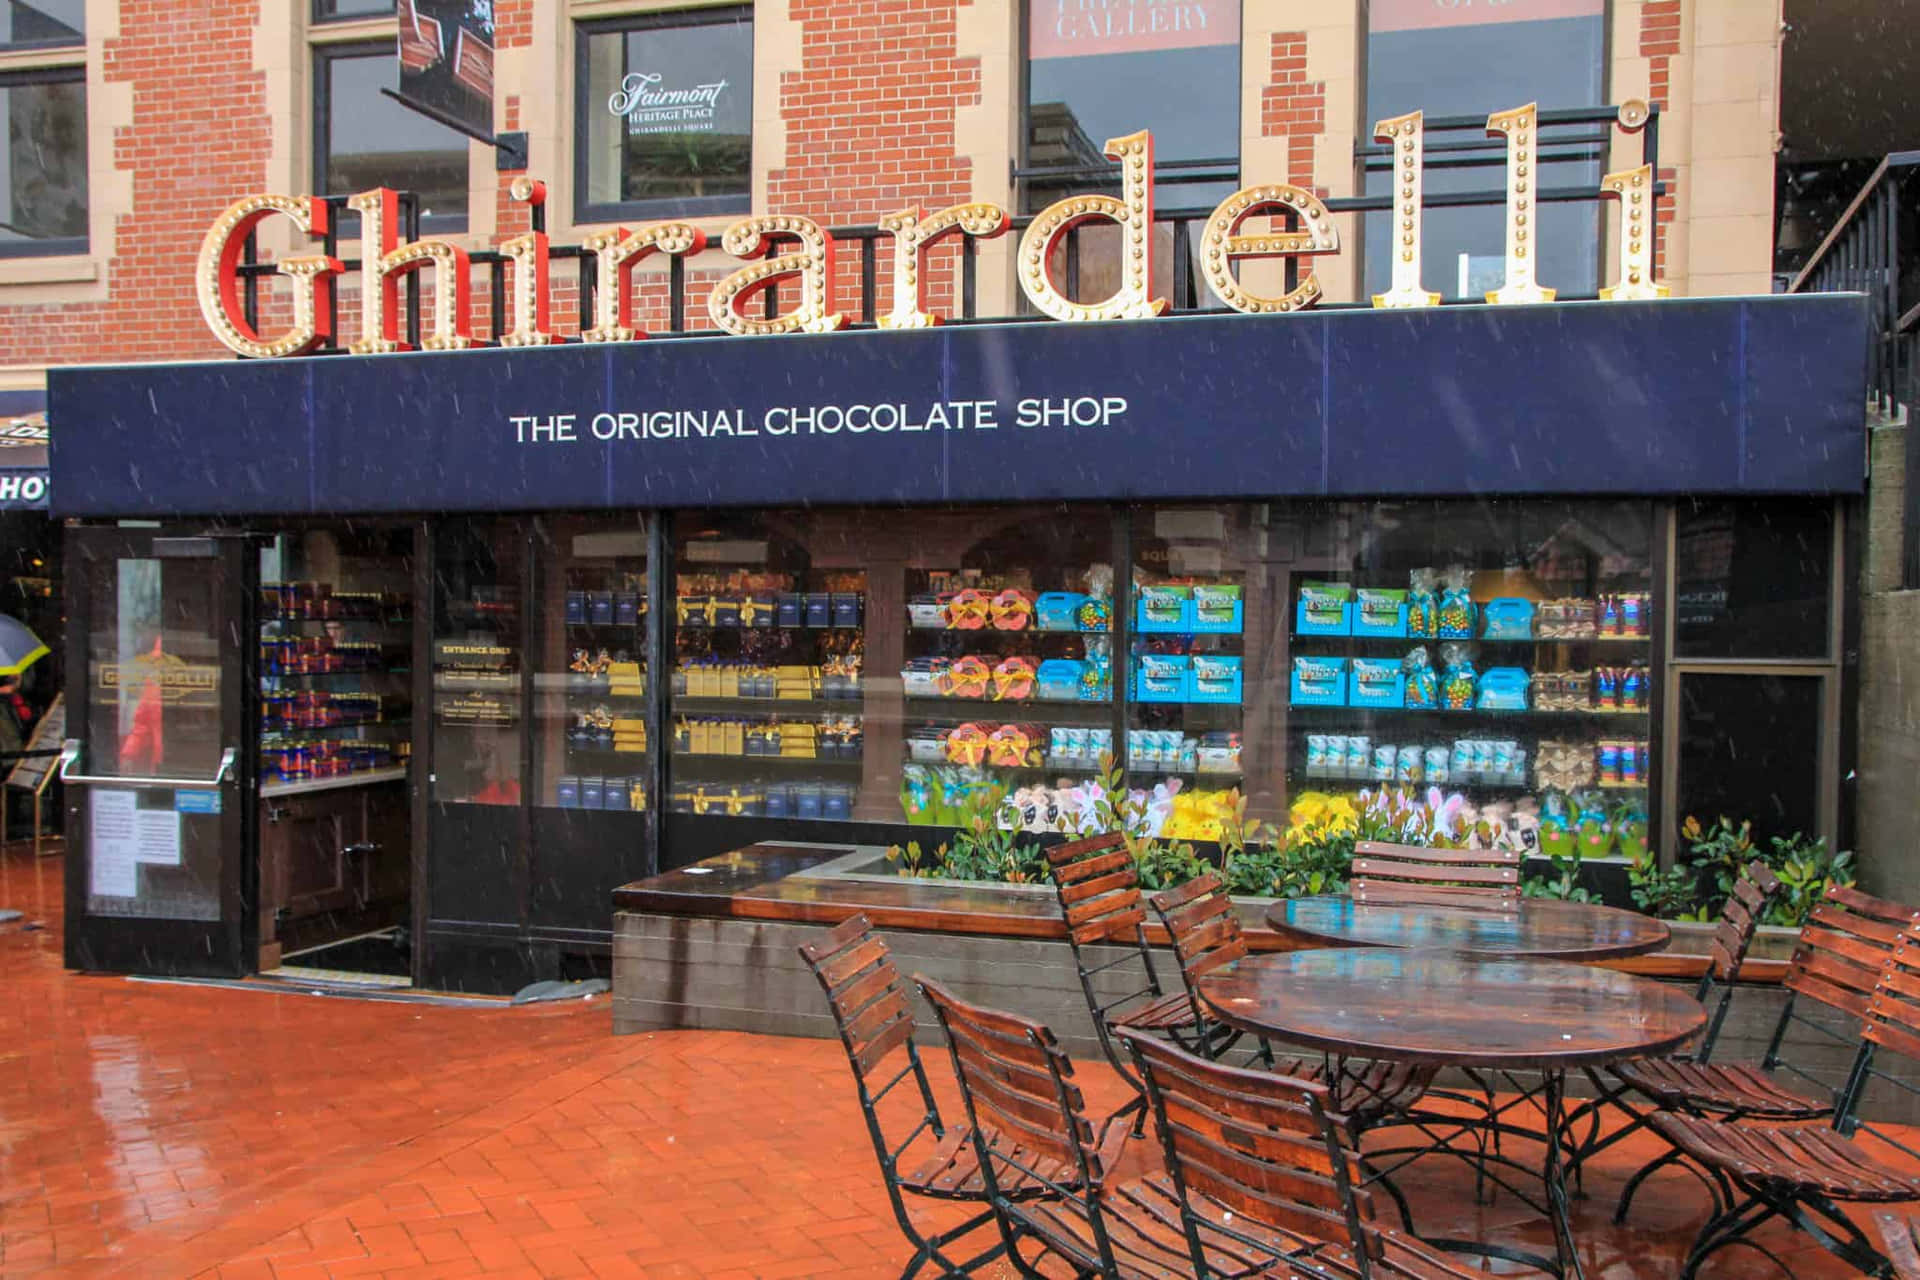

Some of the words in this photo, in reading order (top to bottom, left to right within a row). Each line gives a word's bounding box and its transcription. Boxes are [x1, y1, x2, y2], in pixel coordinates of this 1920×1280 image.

[1056, 4, 1208, 38] GALLERY
[608, 73, 730, 117] Fairmont
[196, 98, 1671, 358] Ghirardelli
[509, 414, 577, 442] THE
[591, 410, 758, 440] ORIGINAL
[764, 399, 998, 435] CHOCOLATE
[1015, 396, 1127, 428] SHOP
[0, 475, 50, 501] HO
